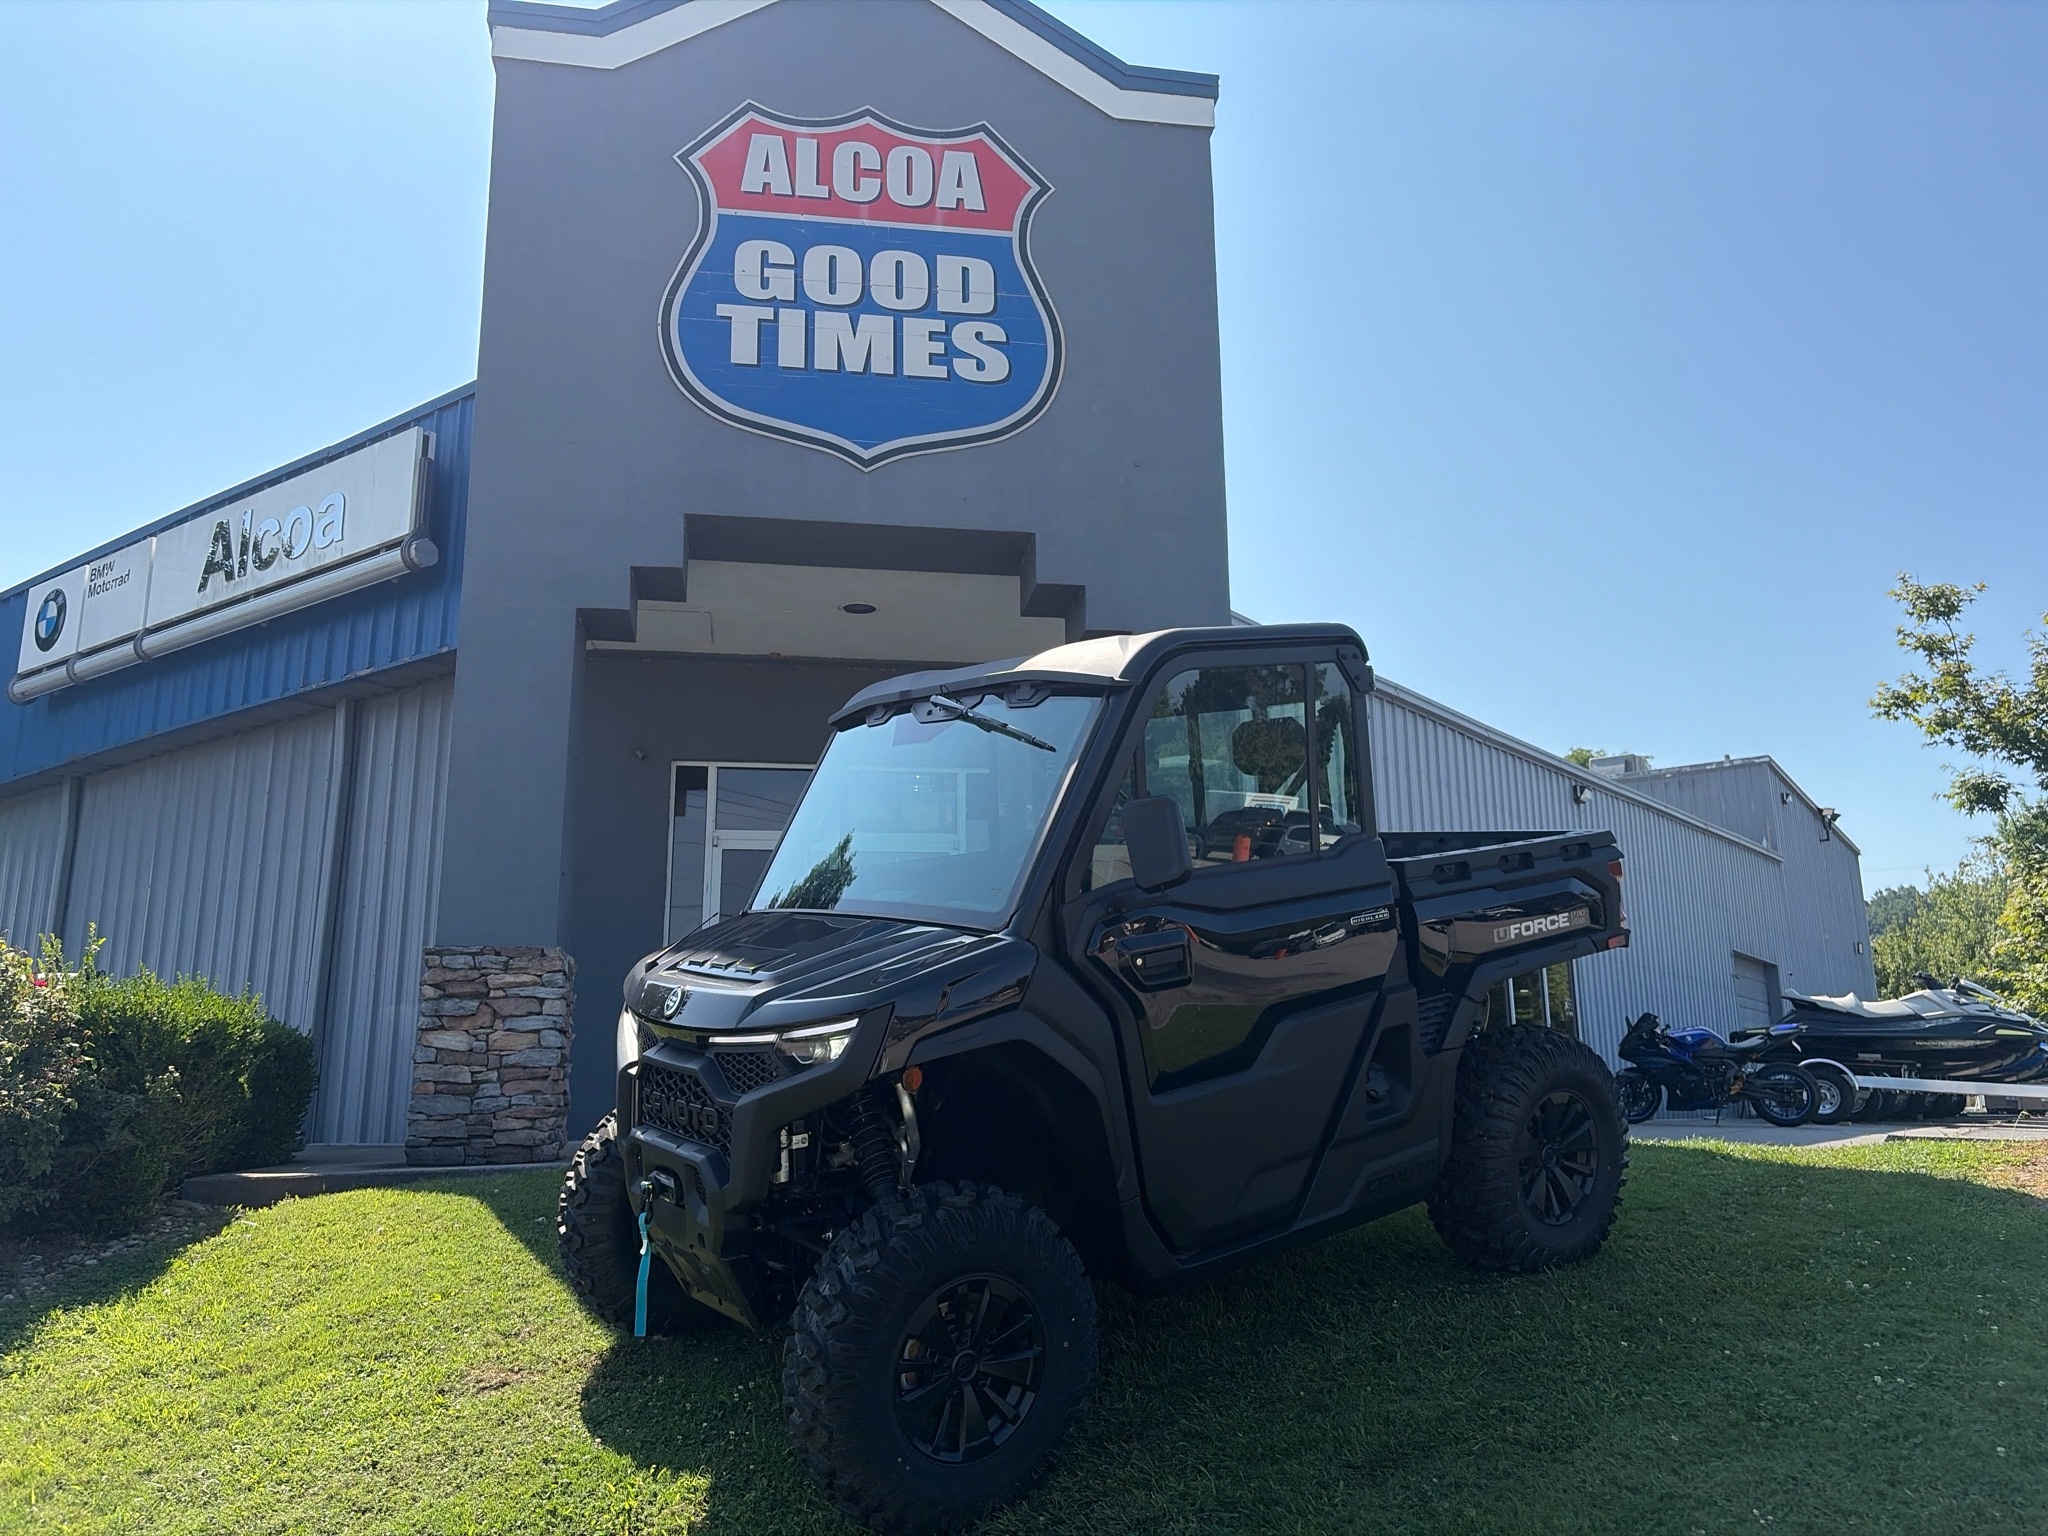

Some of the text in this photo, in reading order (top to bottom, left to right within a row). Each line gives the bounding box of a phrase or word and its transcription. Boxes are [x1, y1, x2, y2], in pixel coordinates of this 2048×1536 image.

[740, 133, 986, 211] ALCOA
[734, 240, 995, 314] GOOD
[716, 303, 1010, 382] TIMES
[90, 560, 115, 582] BMW
[197, 492, 346, 594] Alcoa
[87, 569, 131, 599] Motorrad
[1493, 912, 1570, 944] UFORCE
[642, 1087, 719, 1135] CFMOTO
